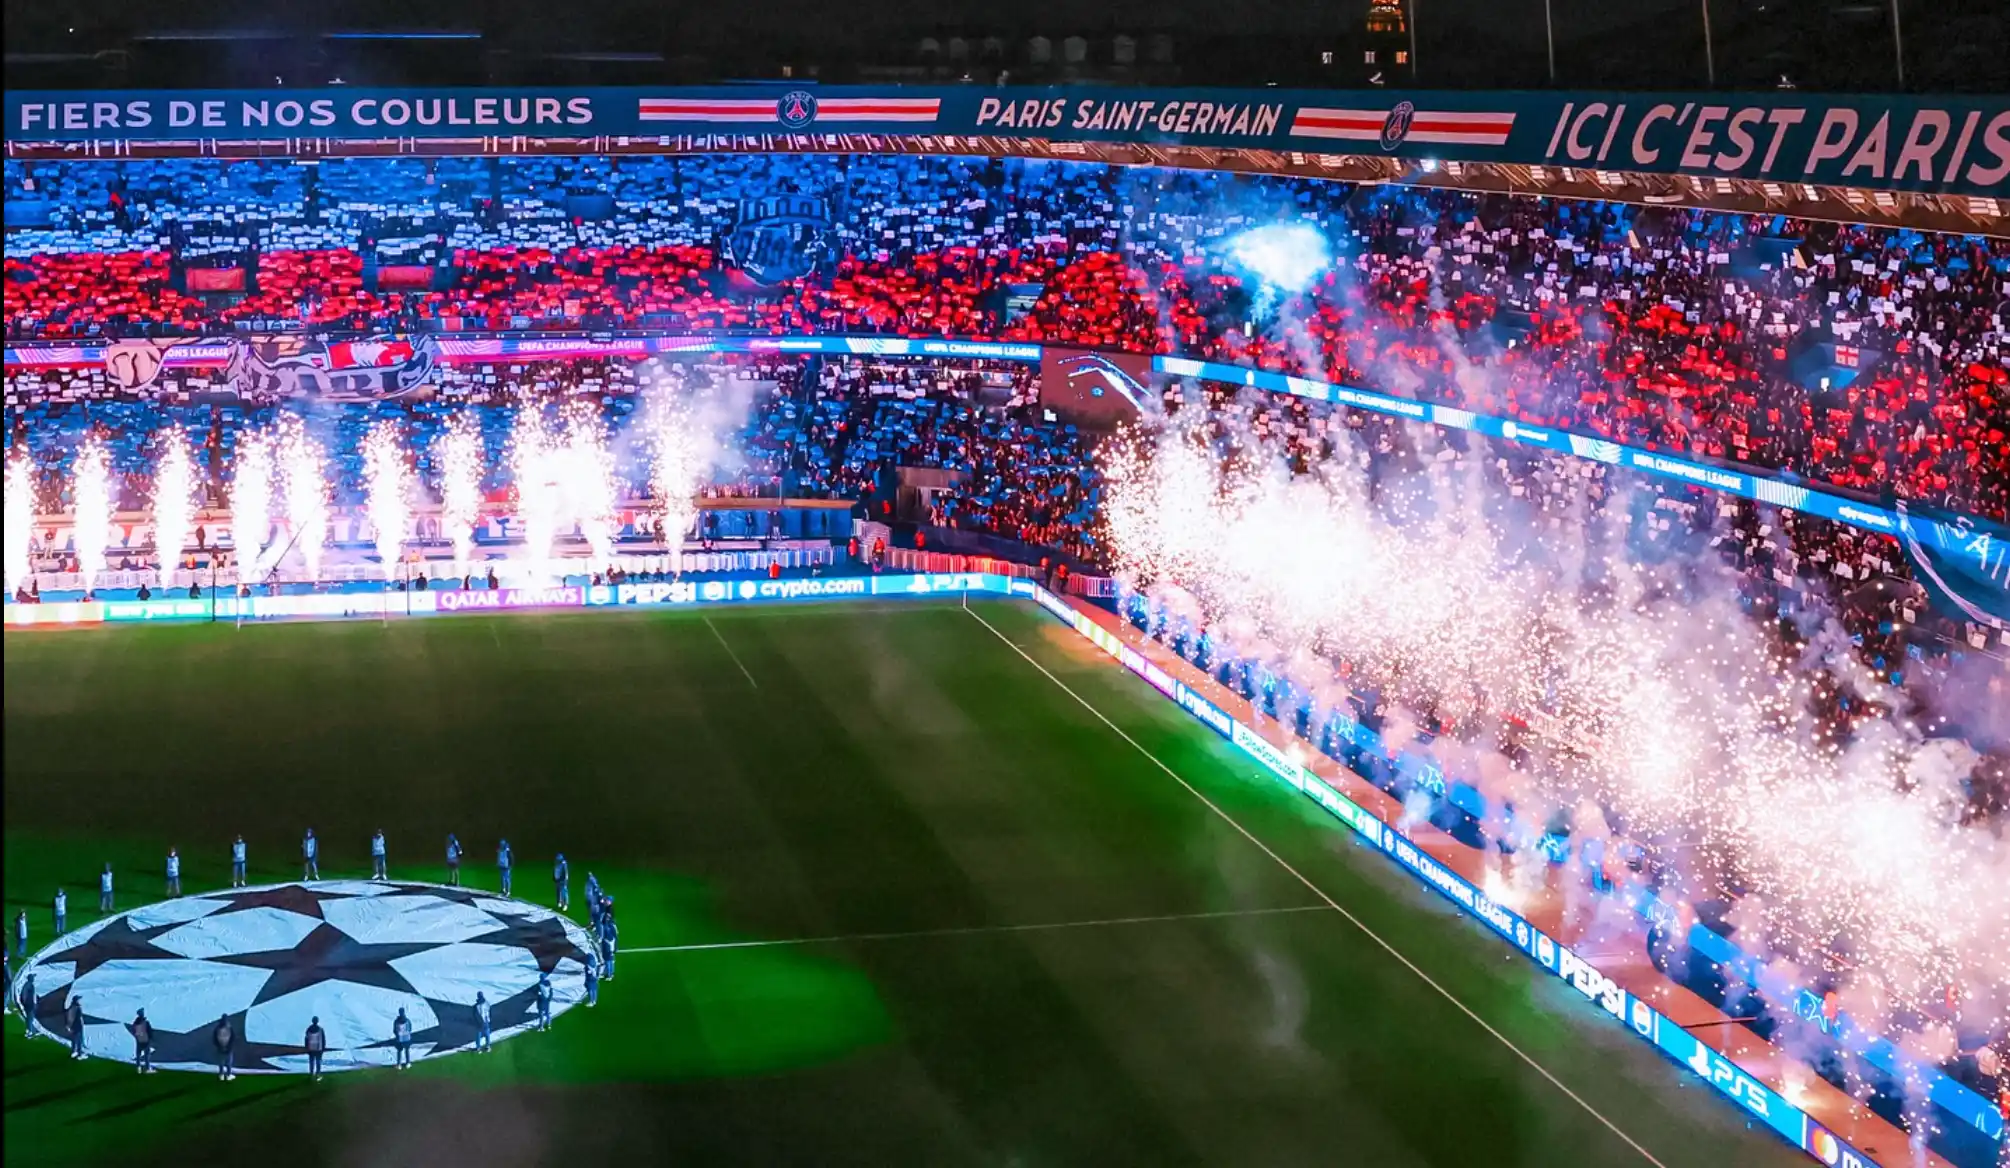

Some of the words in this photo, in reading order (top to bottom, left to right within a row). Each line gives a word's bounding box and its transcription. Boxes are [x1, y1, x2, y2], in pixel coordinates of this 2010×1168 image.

[21, 101, 152, 130] FIERS
[168, 101, 227, 127] DE
[243, 101, 336, 127] NOS
[351, 98, 593, 126] COULEURS
[976, 98, 1067, 129] PARIS
[1071, 99, 1283, 136] SAINT-GERMAIN
[1545, 102, 1626, 161] ICI
[1631, 102, 1806, 172] C'EST
[1803, 108, 2010, 187] PARIS
[189, 347, 229, 358] LEAGUE
[518, 342, 545, 351] UEFA
[1944, 515, 2010, 590] SAI
[440, 590, 500, 611] QATAR
[617, 582, 697, 604] PEPSI
[760, 578, 865, 599] crypto.com
[1395, 839, 1420, 870] UEFA
[1419, 857, 1474, 908] CHAMPIONS
[1474, 892, 1513, 936] LEAGUE
[1559, 945, 1627, 1022] PEPSI
[1713, 1058, 1769, 1117] PS5
[1842, 1150, 1873, 1168] m
